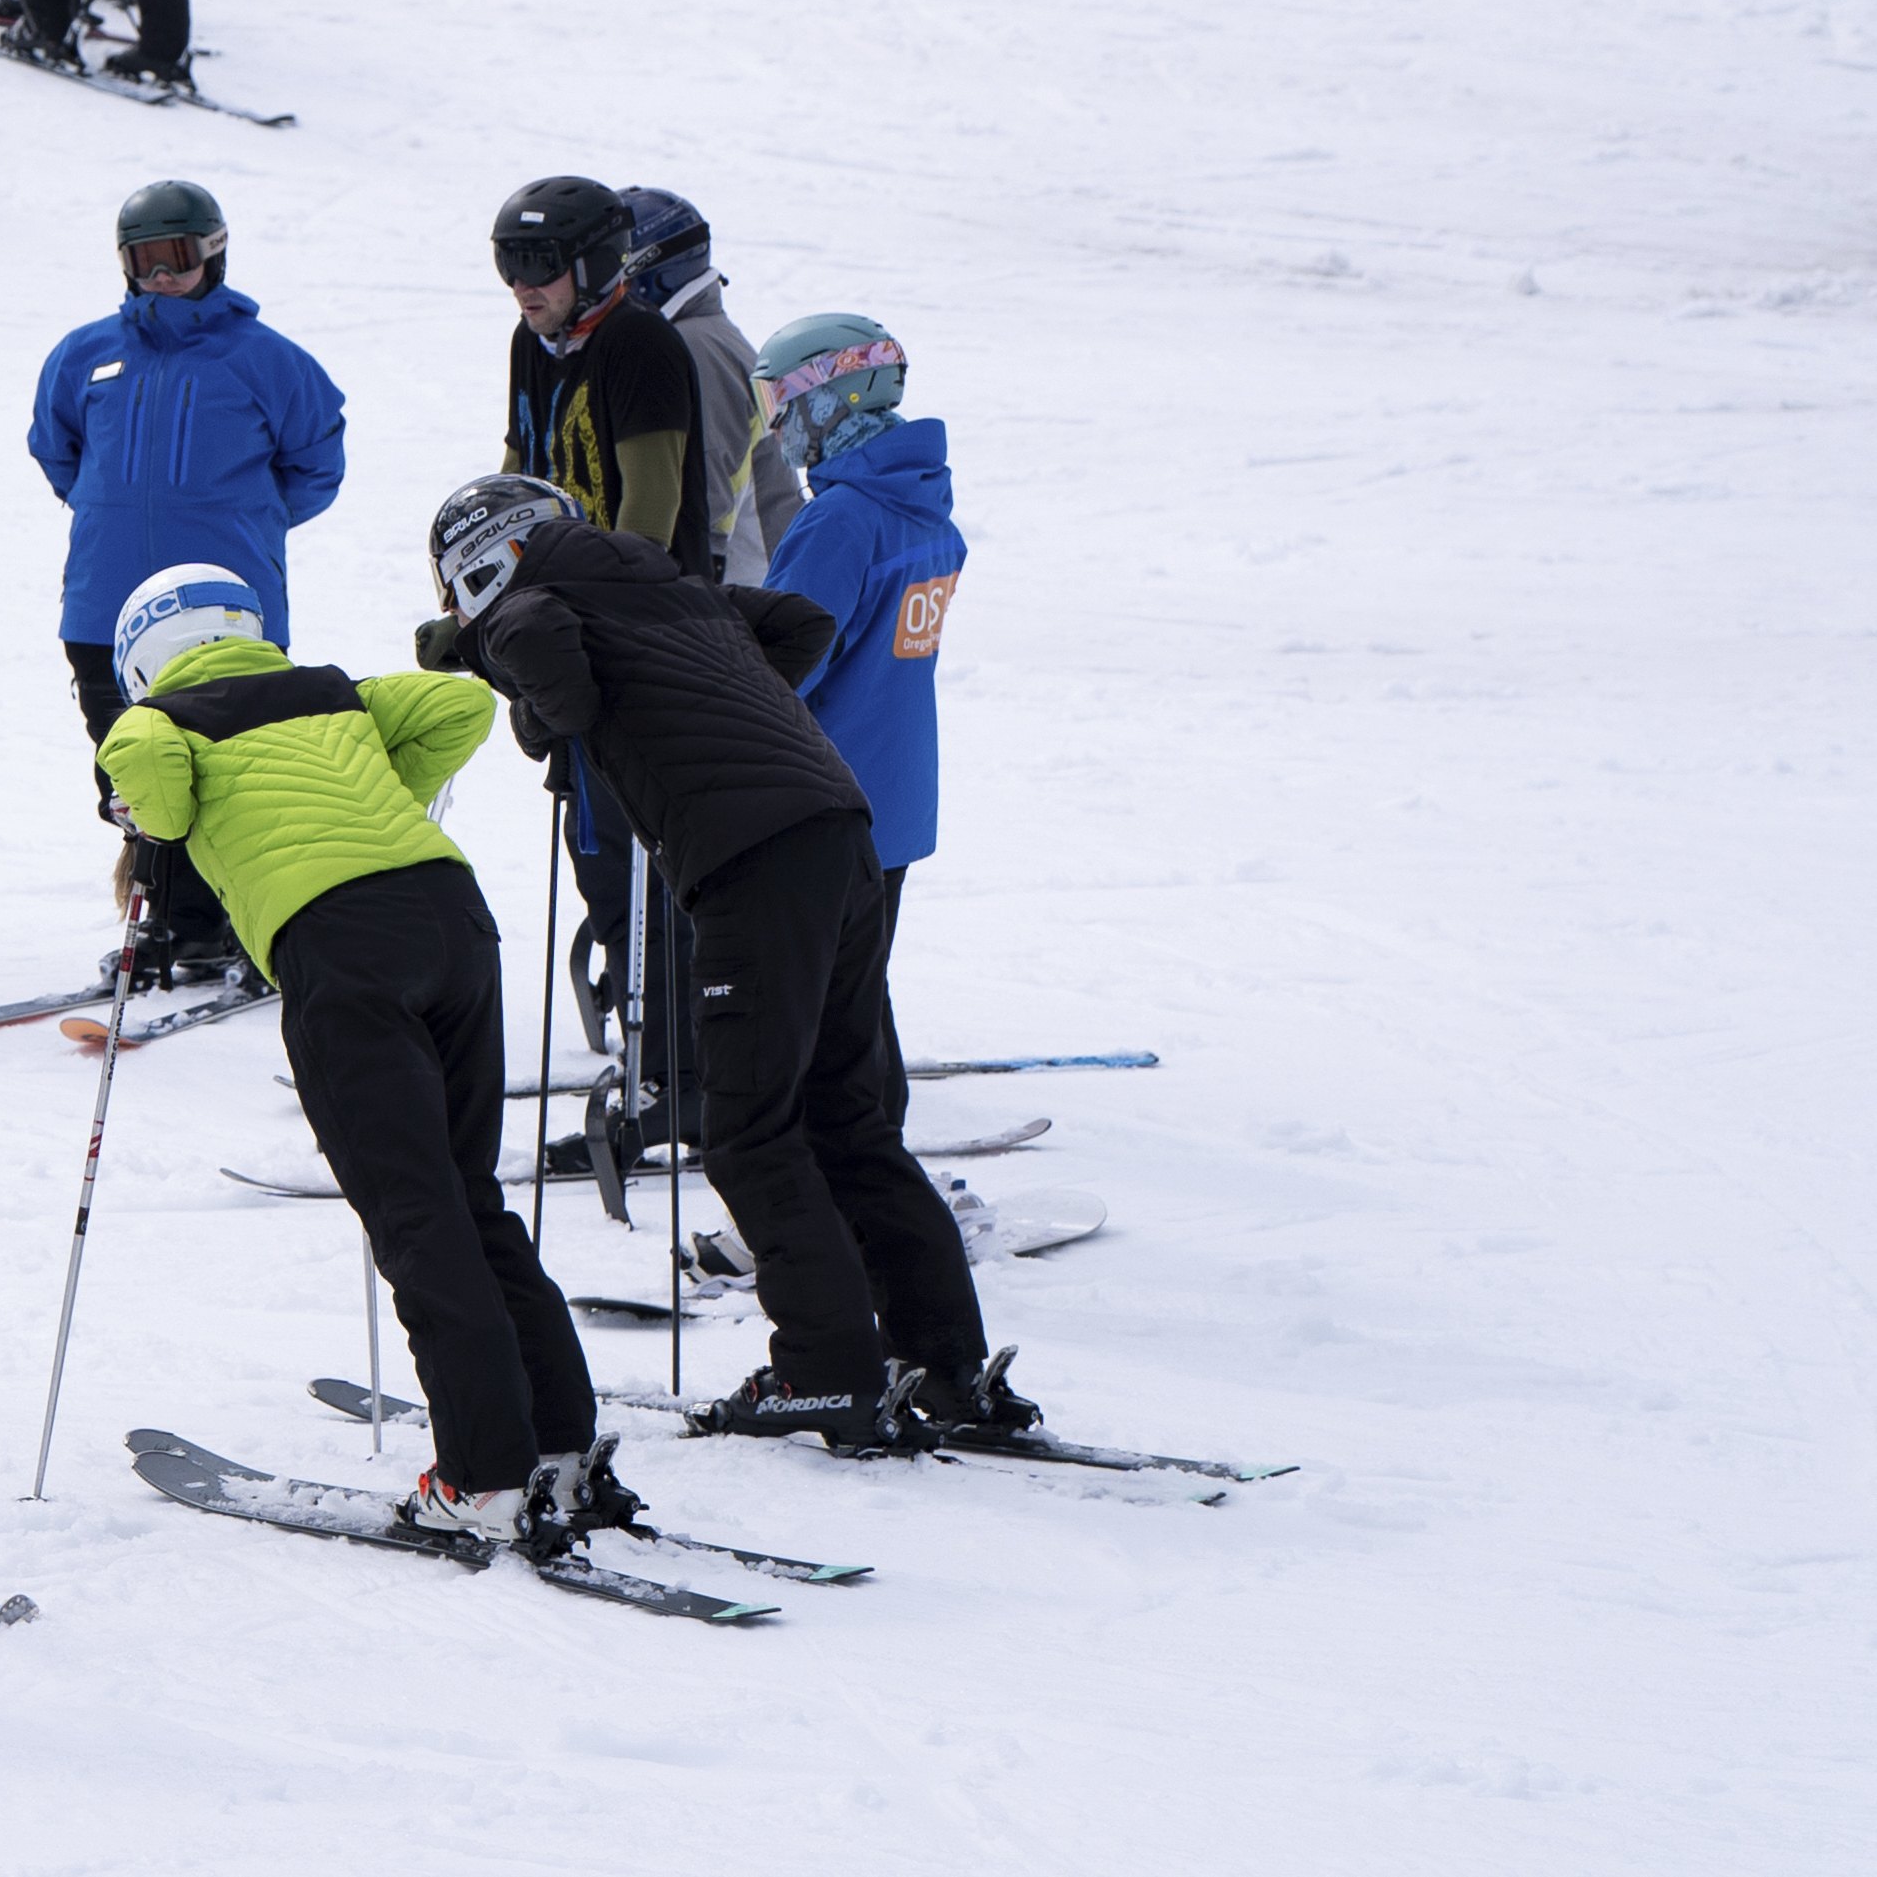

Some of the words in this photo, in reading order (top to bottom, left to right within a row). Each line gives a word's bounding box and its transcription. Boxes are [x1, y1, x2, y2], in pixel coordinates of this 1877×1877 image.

[443, 506, 489, 545] BRIKO
[460, 507, 536, 560] BRIKO
[755, 1394, 853, 1415] NORDICA
